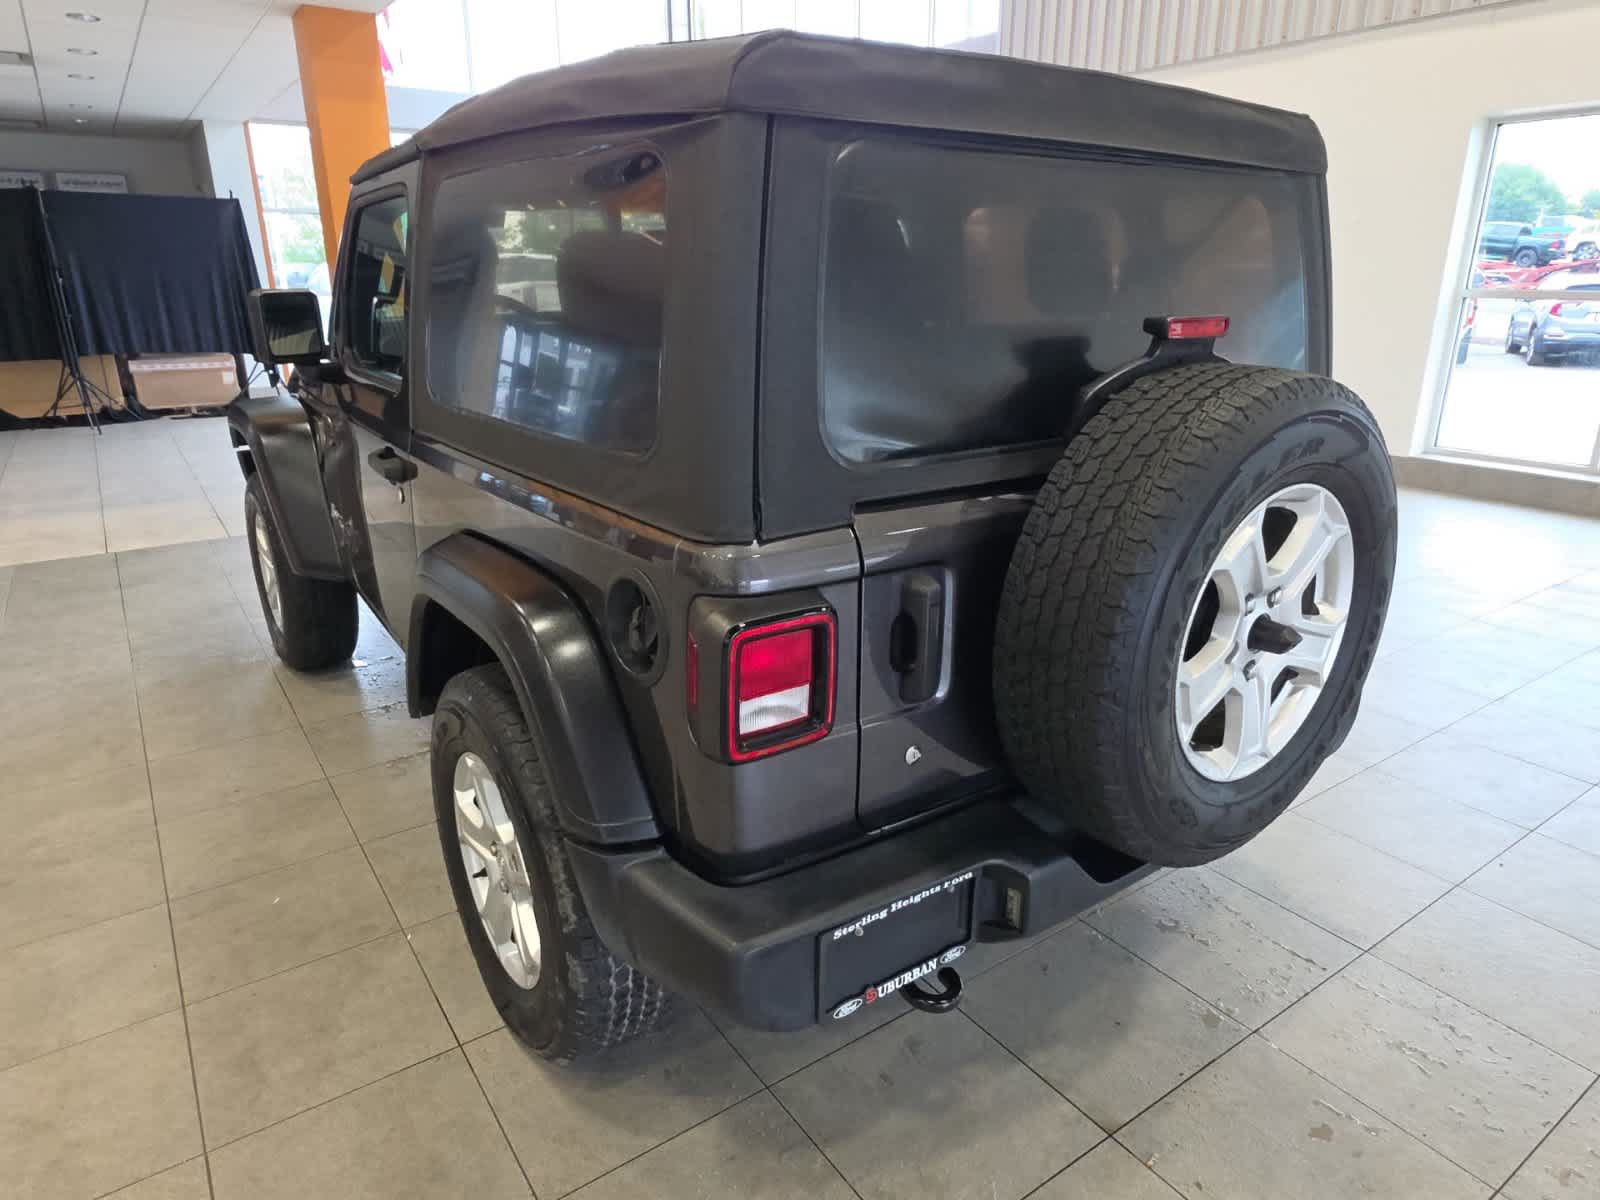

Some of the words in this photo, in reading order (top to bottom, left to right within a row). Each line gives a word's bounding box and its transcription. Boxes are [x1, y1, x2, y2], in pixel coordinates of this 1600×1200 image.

[833, 908, 889, 940] Sterling
[890, 884, 941, 913] Heights
[865, 958, 938, 1004] SUBURBAN
